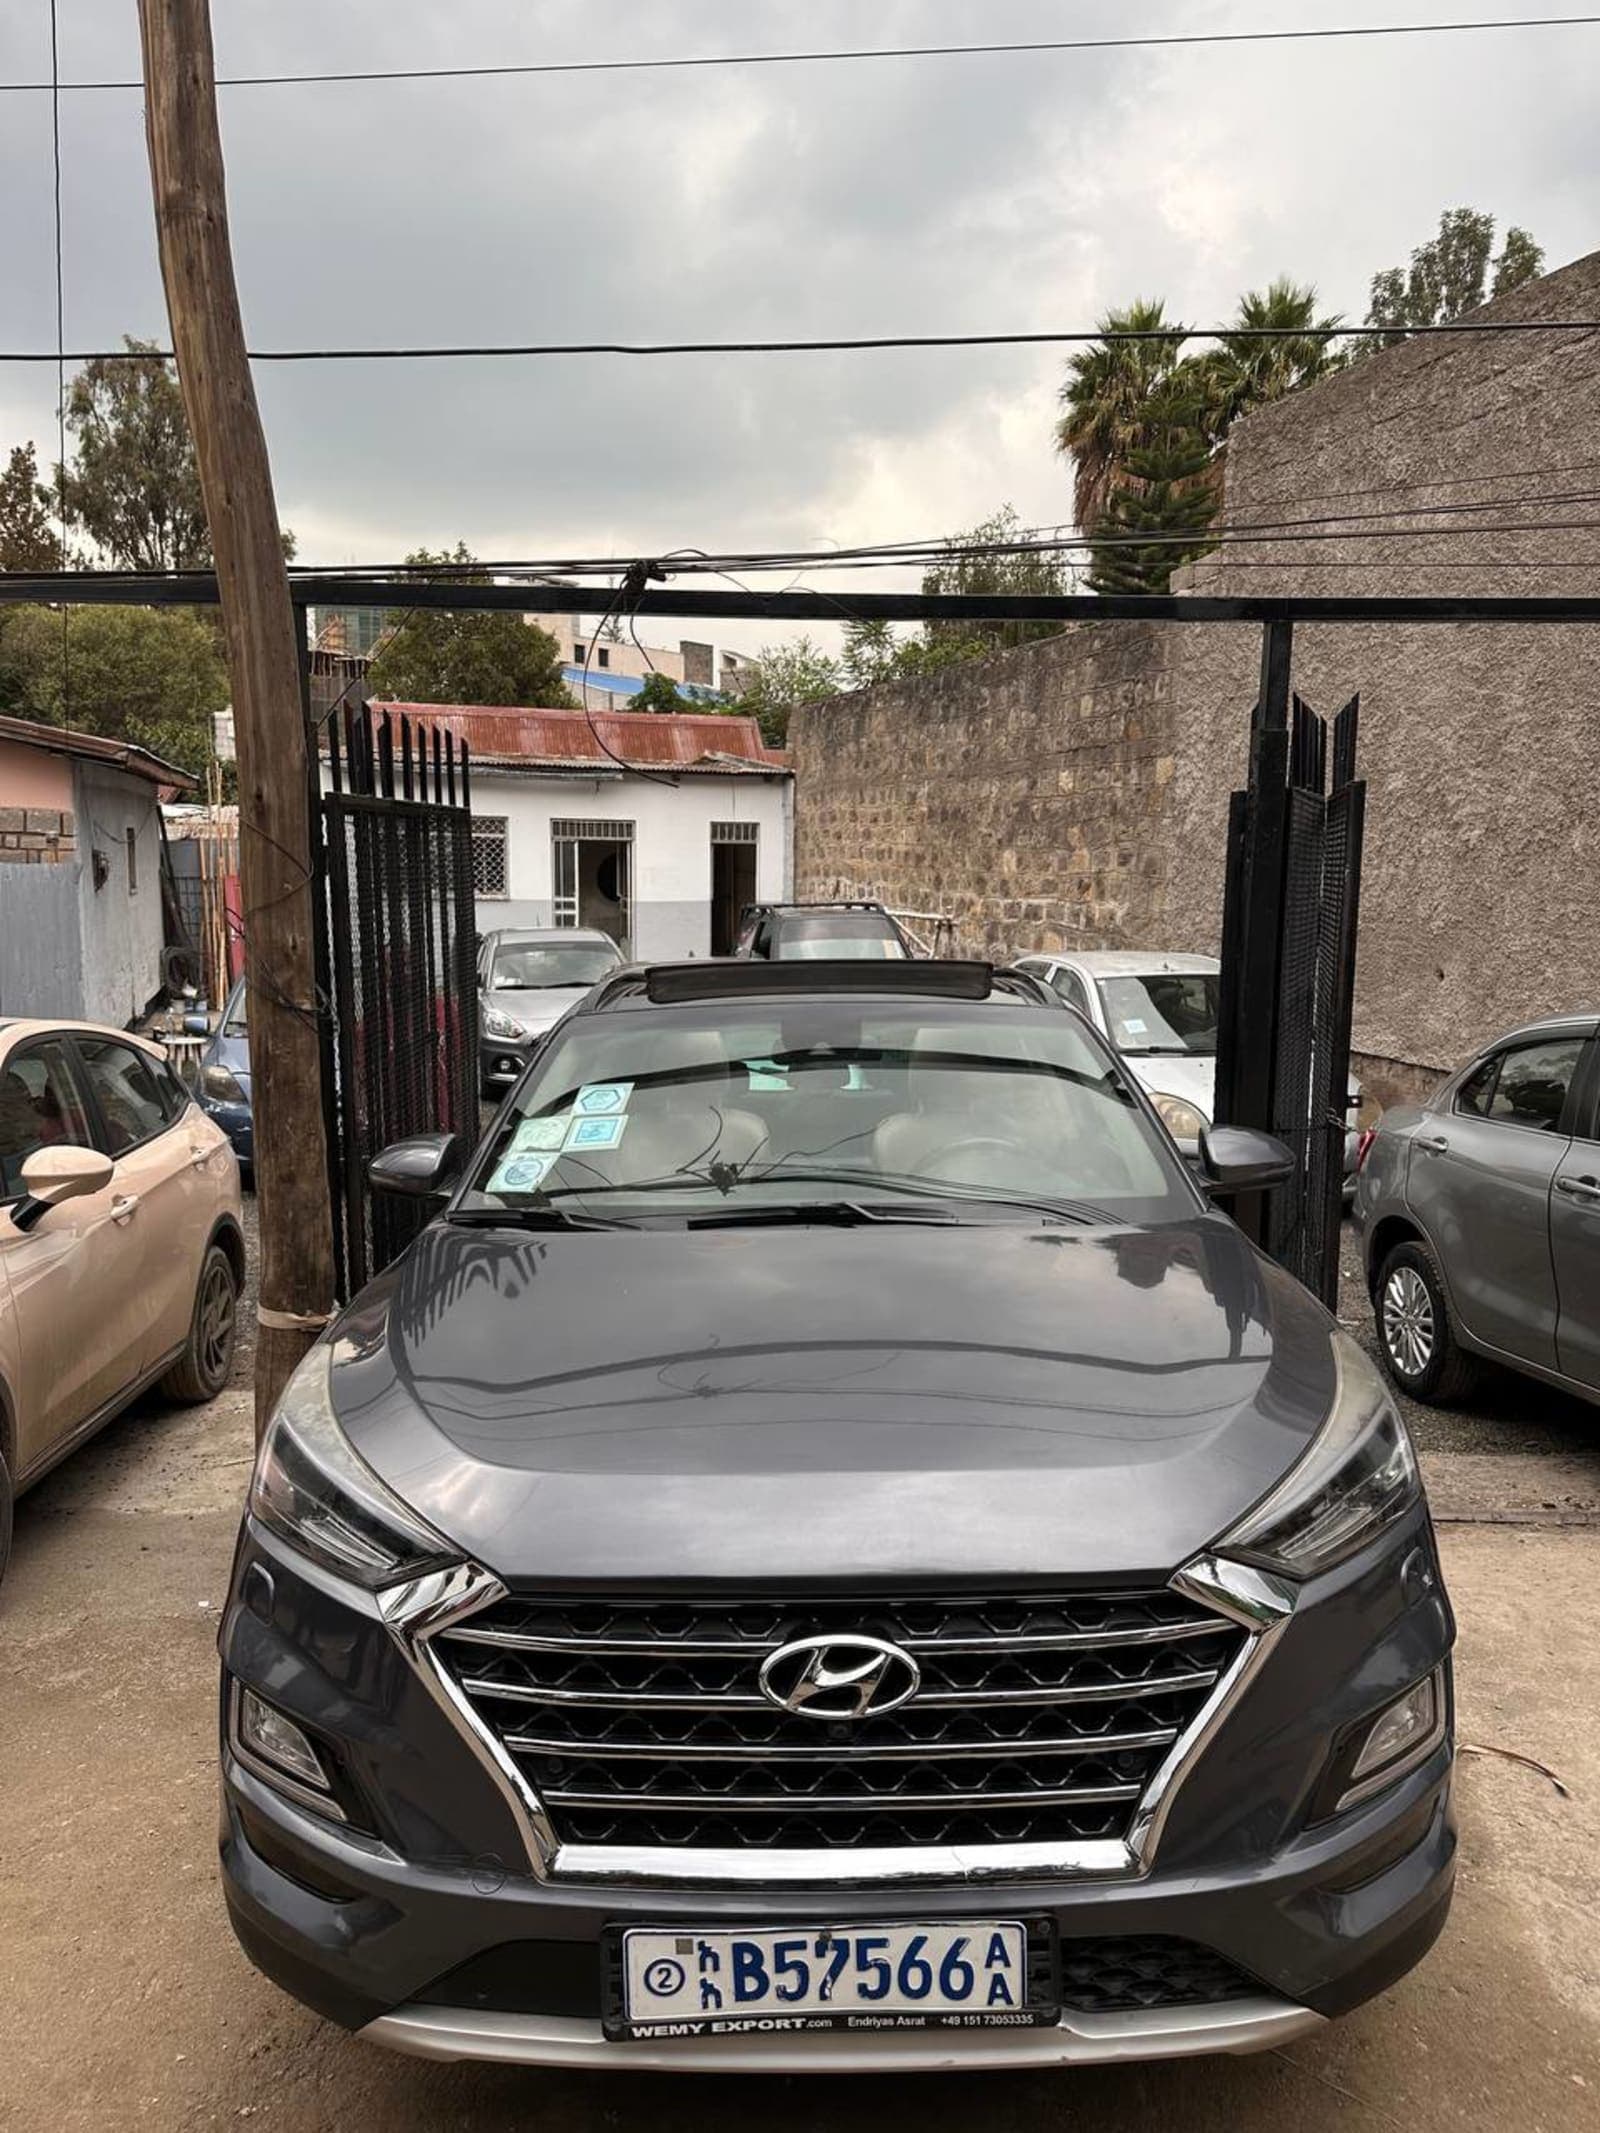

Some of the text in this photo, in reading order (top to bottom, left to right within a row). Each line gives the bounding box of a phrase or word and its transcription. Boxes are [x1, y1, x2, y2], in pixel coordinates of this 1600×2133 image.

[732, 1936, 974, 2002] B57566
[657, 1967, 672, 1989] 2
[848, 2016, 925, 2027] Endriyas Asrat
[941, 2016, 960, 2025] +49
[964, 2015, 981, 2025] 151
[632, 2023, 705, 2037] WEMY
